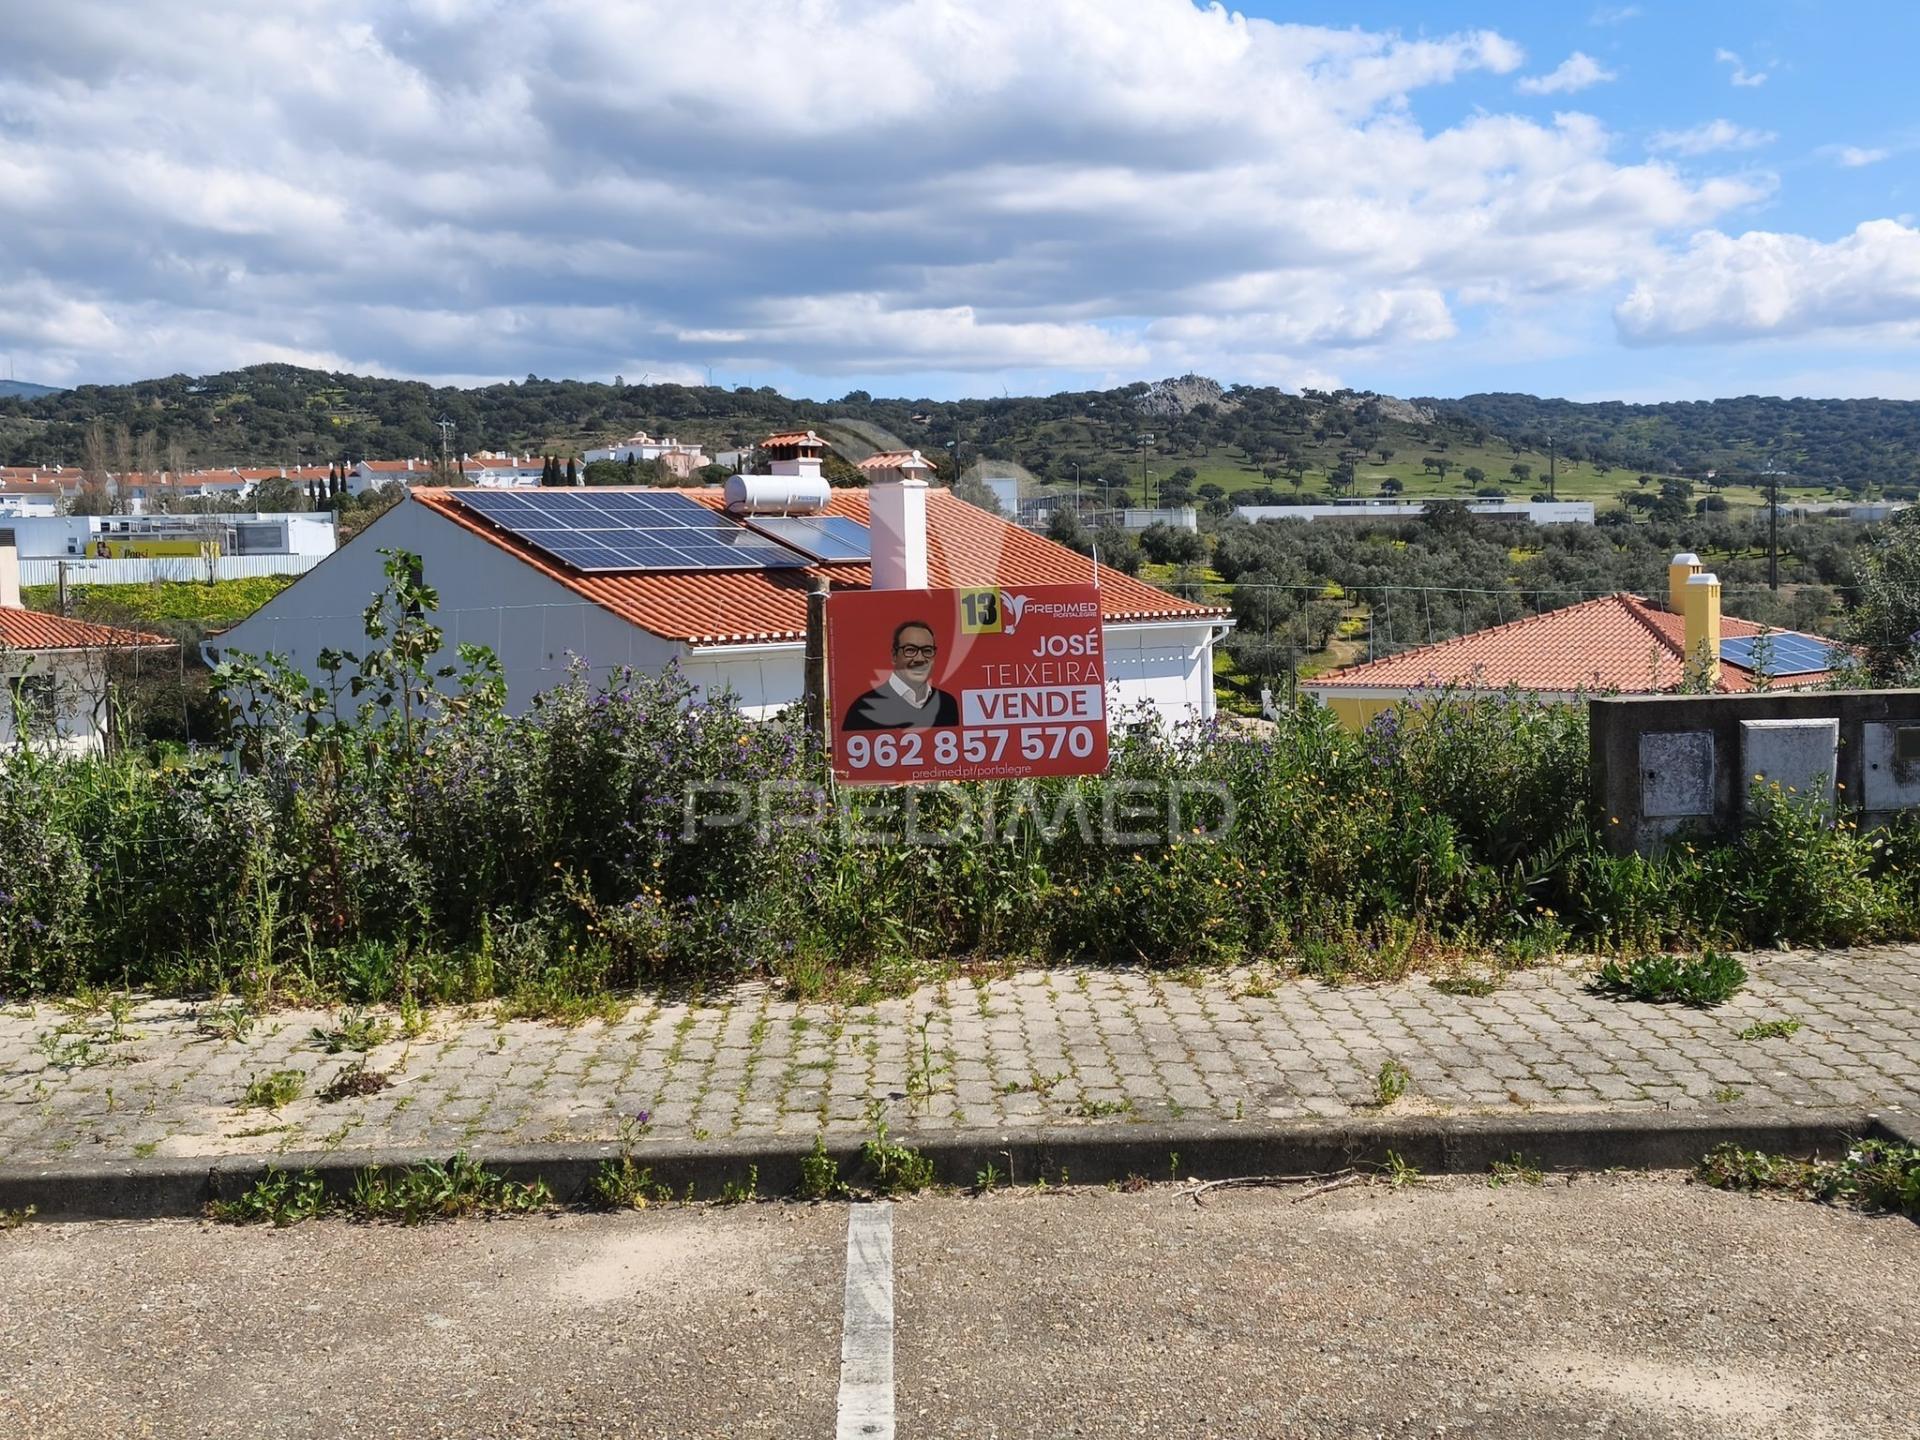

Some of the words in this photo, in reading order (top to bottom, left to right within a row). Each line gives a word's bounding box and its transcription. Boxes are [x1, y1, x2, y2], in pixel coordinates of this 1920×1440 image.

[961, 592, 997, 626] 13
[1024, 602, 1098, 613] PREDIMED
[1032, 627, 1099, 657] JOSÉ
[982, 661, 1100, 686] TEIXEIRA
[977, 690, 1088, 720] VENDE
[846, 733, 924, 768] 962
[934, 730, 1009, 763] 857
[1020, 726, 1094, 760] 570
[912, 763, 1032, 780] predimed.pt/portalegre
